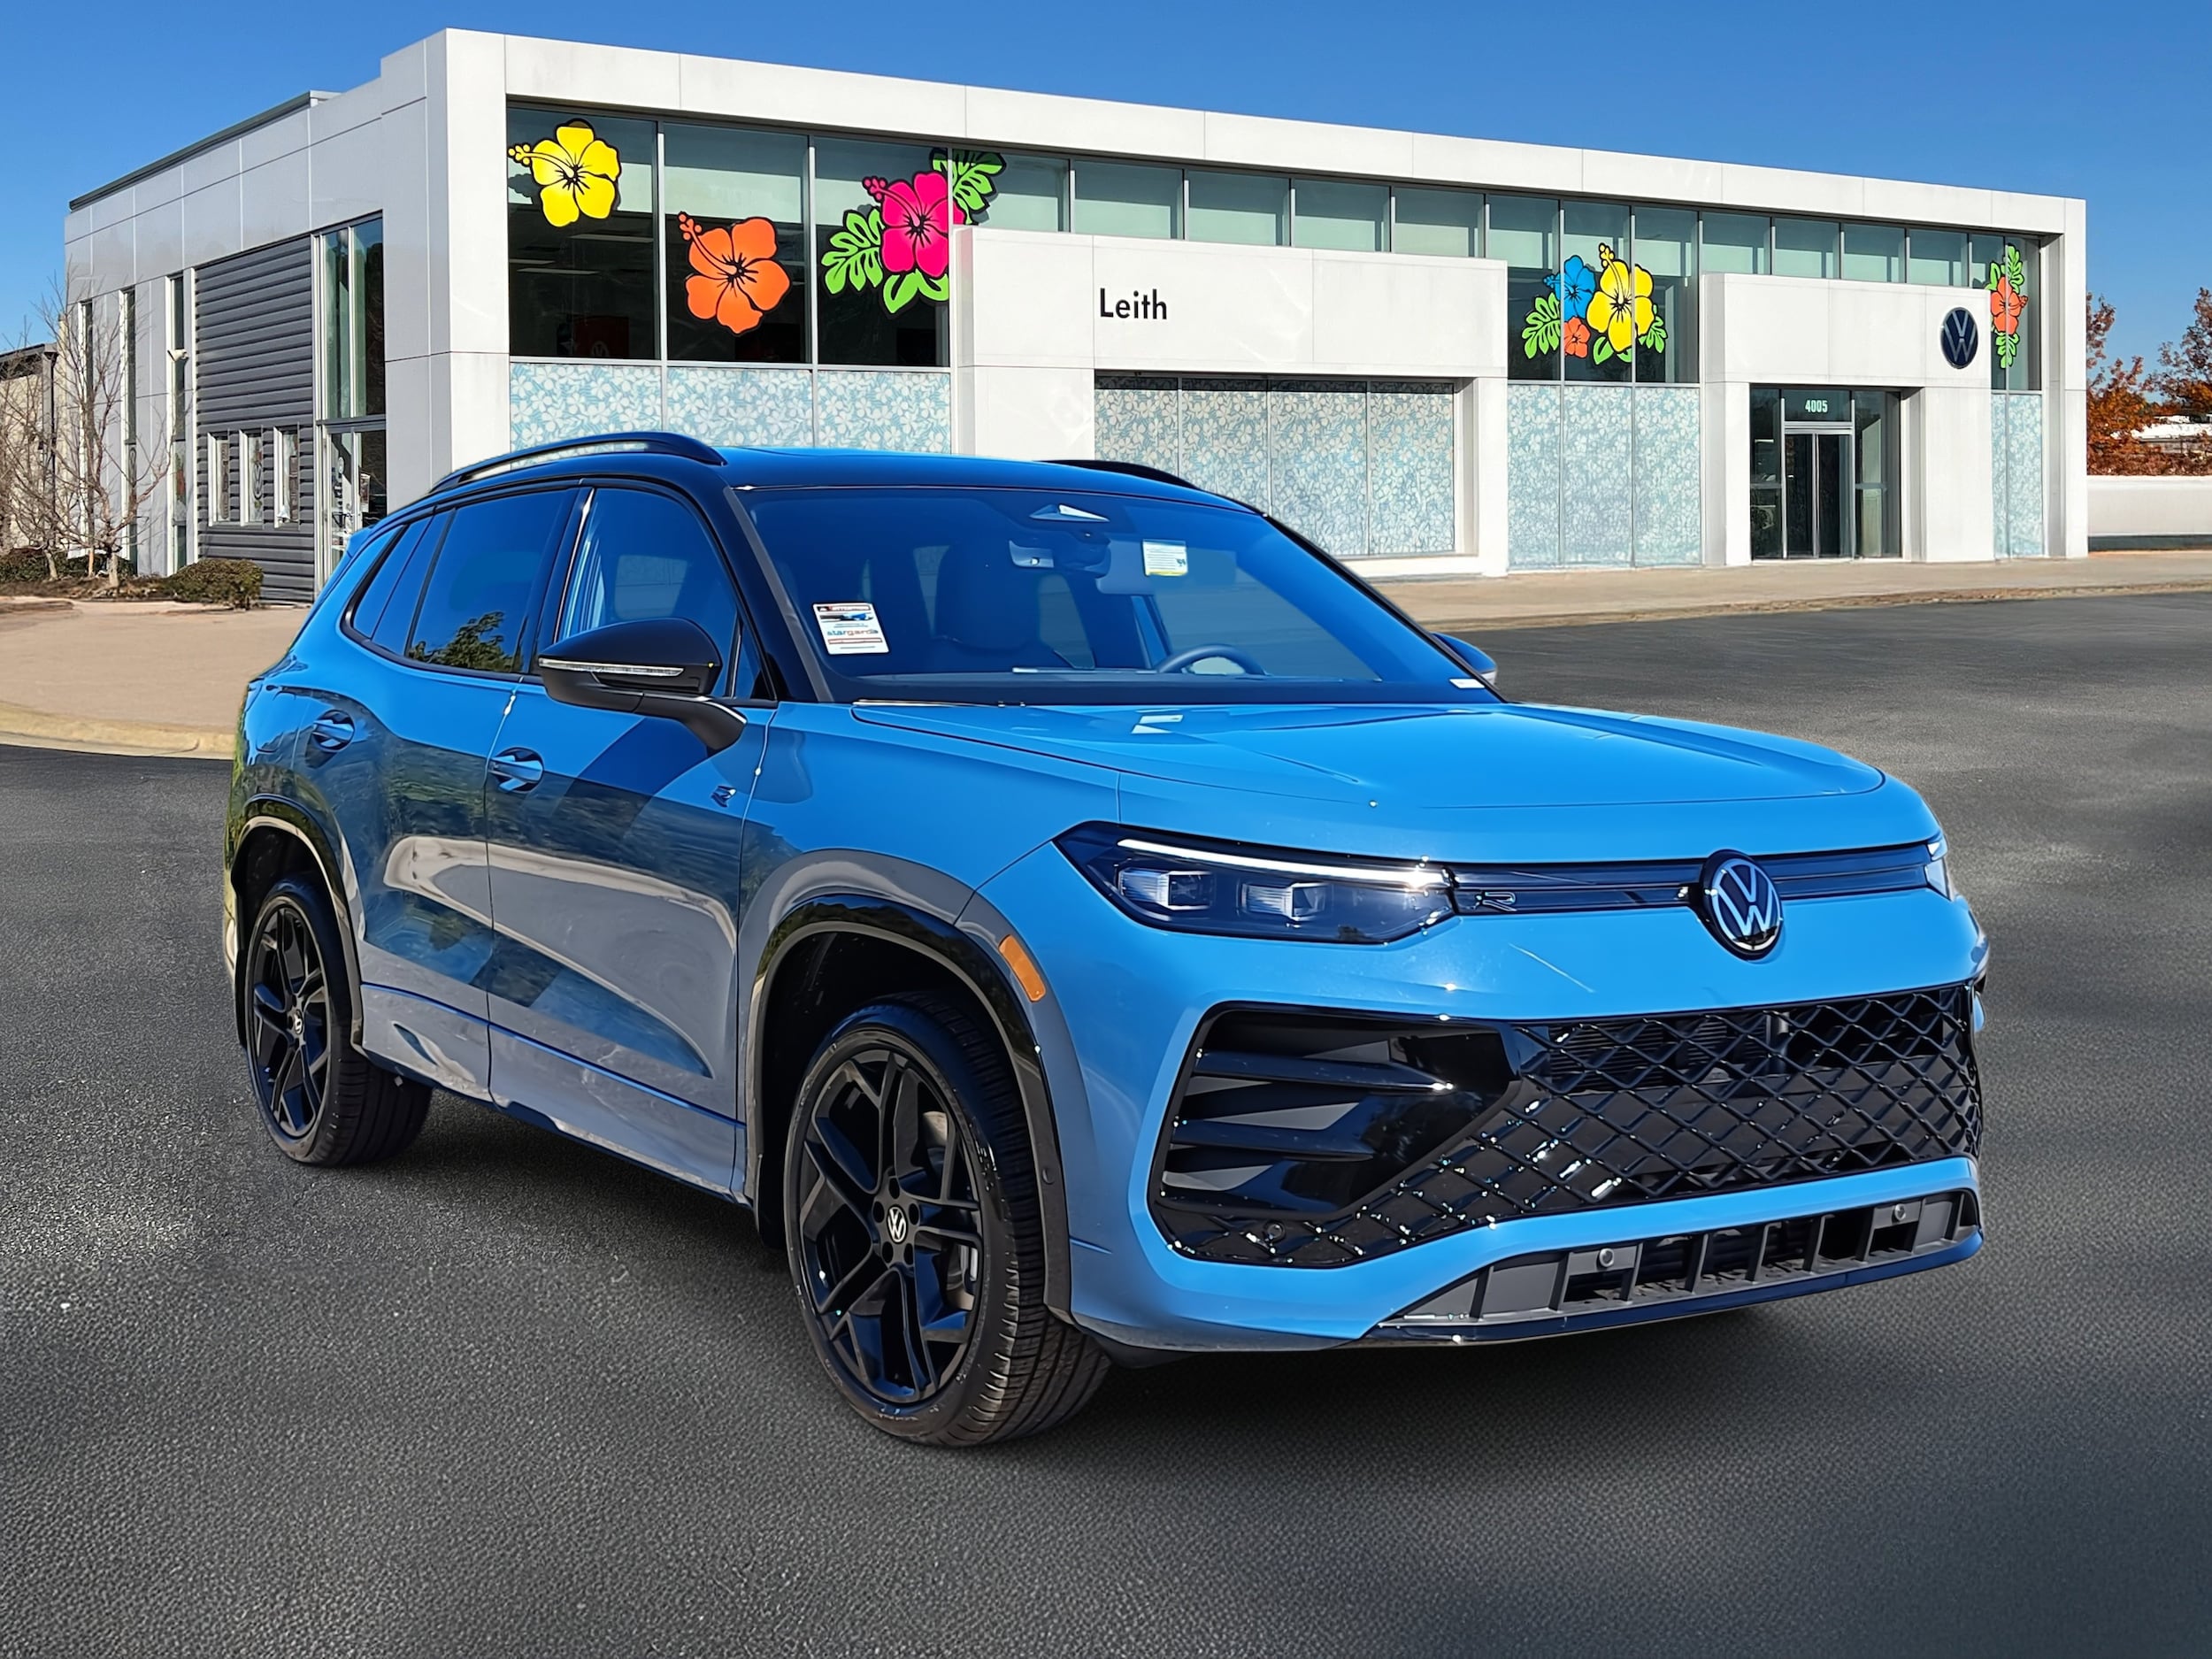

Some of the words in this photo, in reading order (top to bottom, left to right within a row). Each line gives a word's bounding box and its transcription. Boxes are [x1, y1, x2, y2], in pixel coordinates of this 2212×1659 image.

[1100, 287, 1168, 320] Leith
[1941, 307, 1978, 368] VW
[1805, 399, 1828, 413] 4005
[1711, 857, 1781, 951] VW
[887, 1206, 907, 1243] VW
